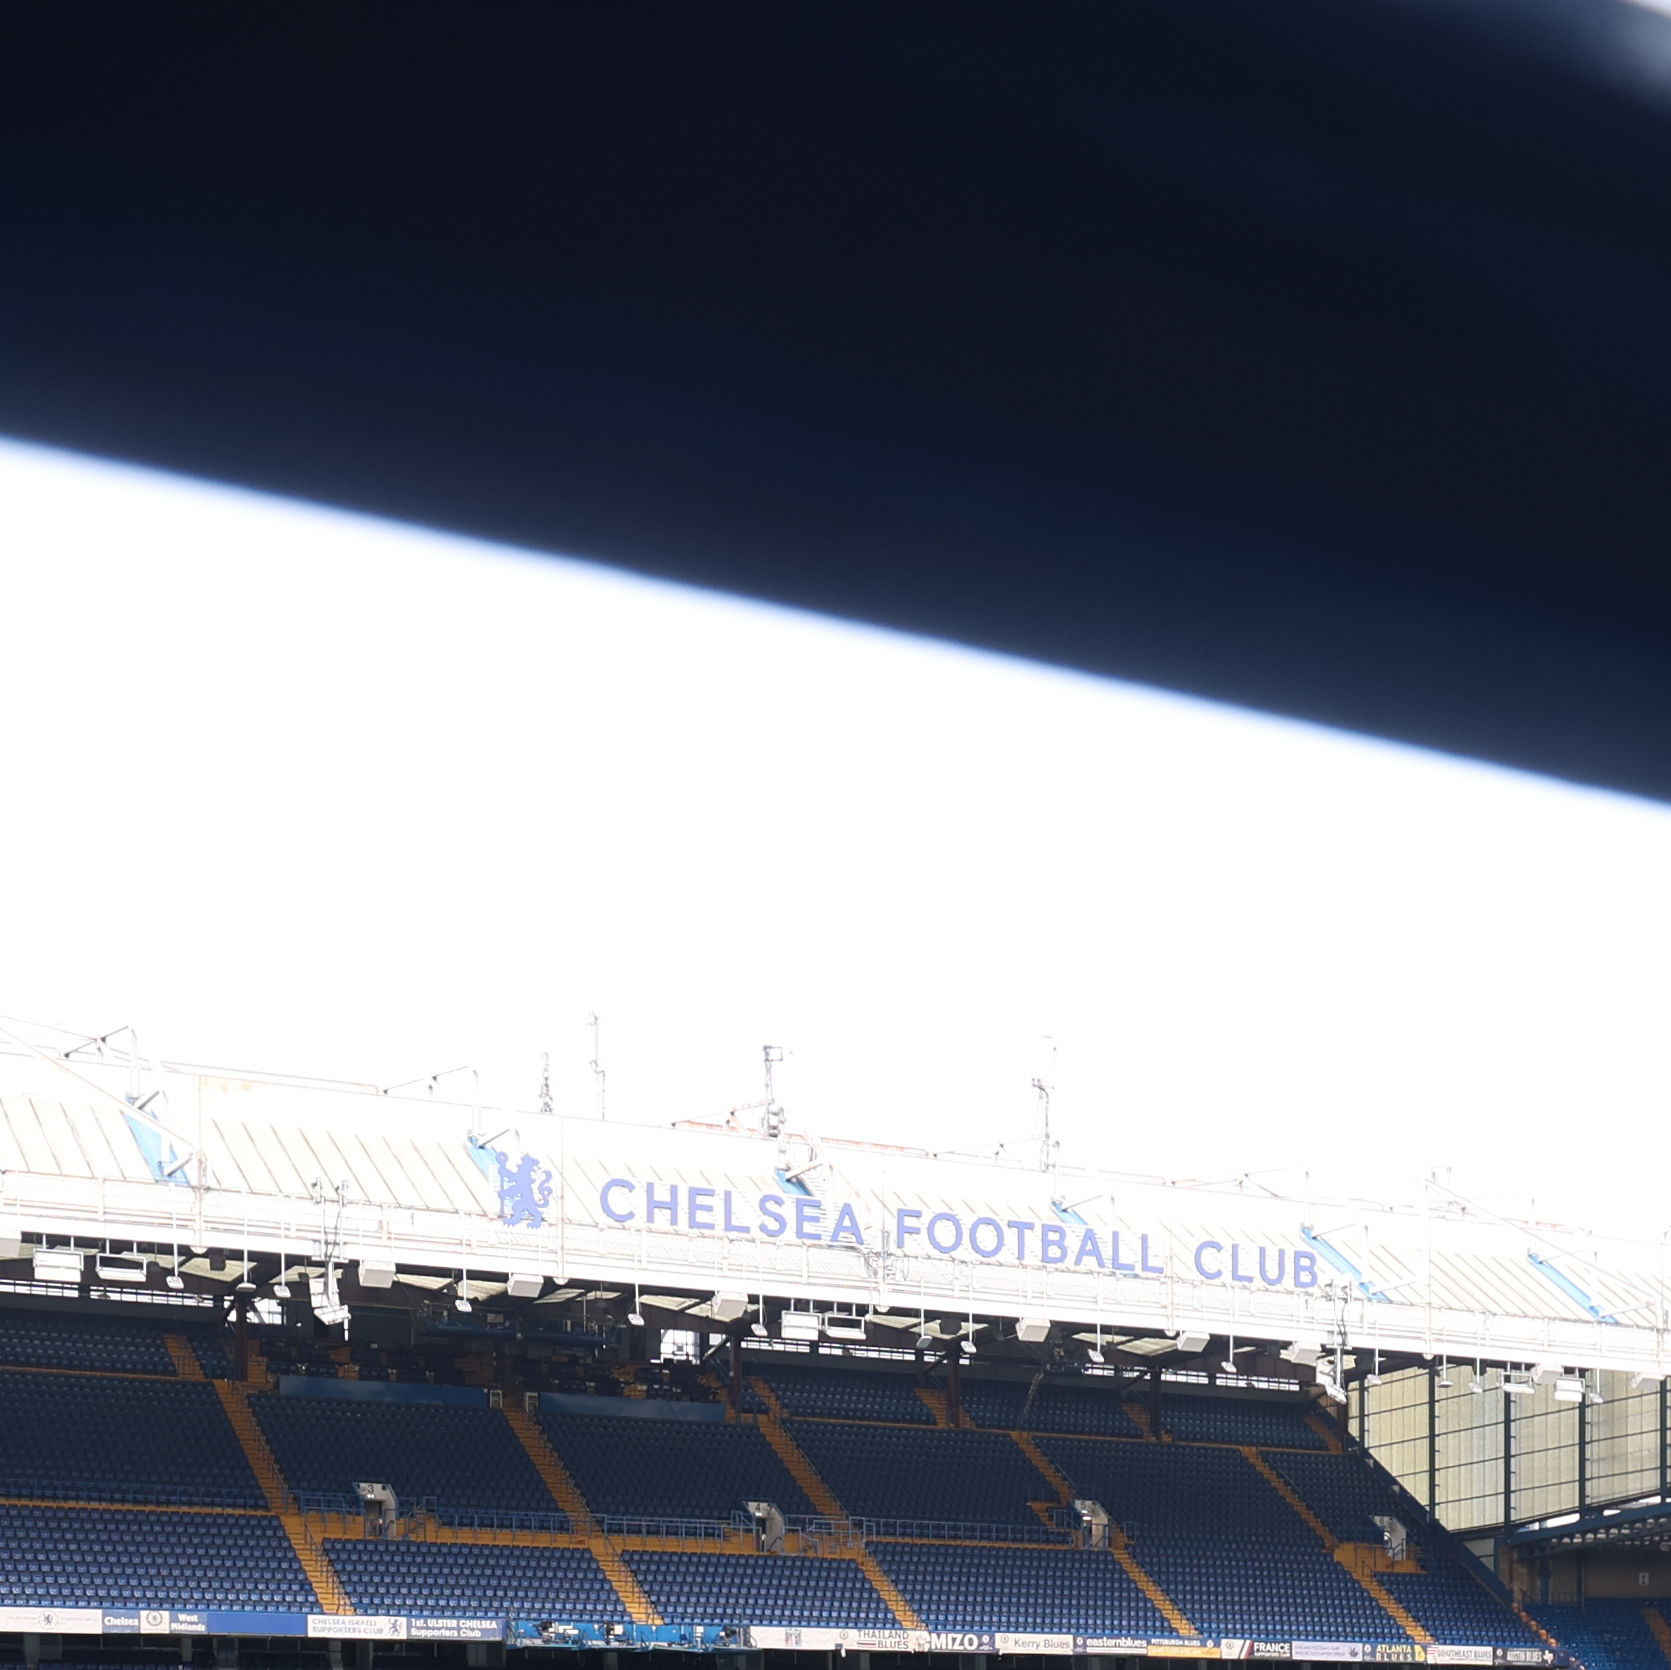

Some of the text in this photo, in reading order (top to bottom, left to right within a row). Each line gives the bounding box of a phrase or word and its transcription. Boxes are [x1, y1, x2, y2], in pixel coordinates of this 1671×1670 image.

[600, 1178, 1318, 1288] CHELSEA FOOTBALL CLUB
[367, 1484, 374, 1493] 3
[755, 1503, 761, 1511] 4
[104, 1616, 139, 1626] Chelsea
[178, 1614, 198, 1622] West
[312, 1618, 344, 1626] CHELSEA
[171, 1622, 206, 1632] Midlands
[411, 1618, 497, 1629] 1st. ULSTER CHELSEA
[411, 1628, 481, 1638] Supporters Club
[857, 1630, 909, 1640] THAILAND
[878, 1640, 909, 1650] BLUES
[931, 1633, 978, 1650] MIZO
[1014, 1638, 1070, 1650] Kerry Blues
[1086, 1637, 1147, 1648] easternblues
[1254, 1642, 1290, 1652] FRANCE
[1376, 1644, 1412, 1654] ATLANTA
